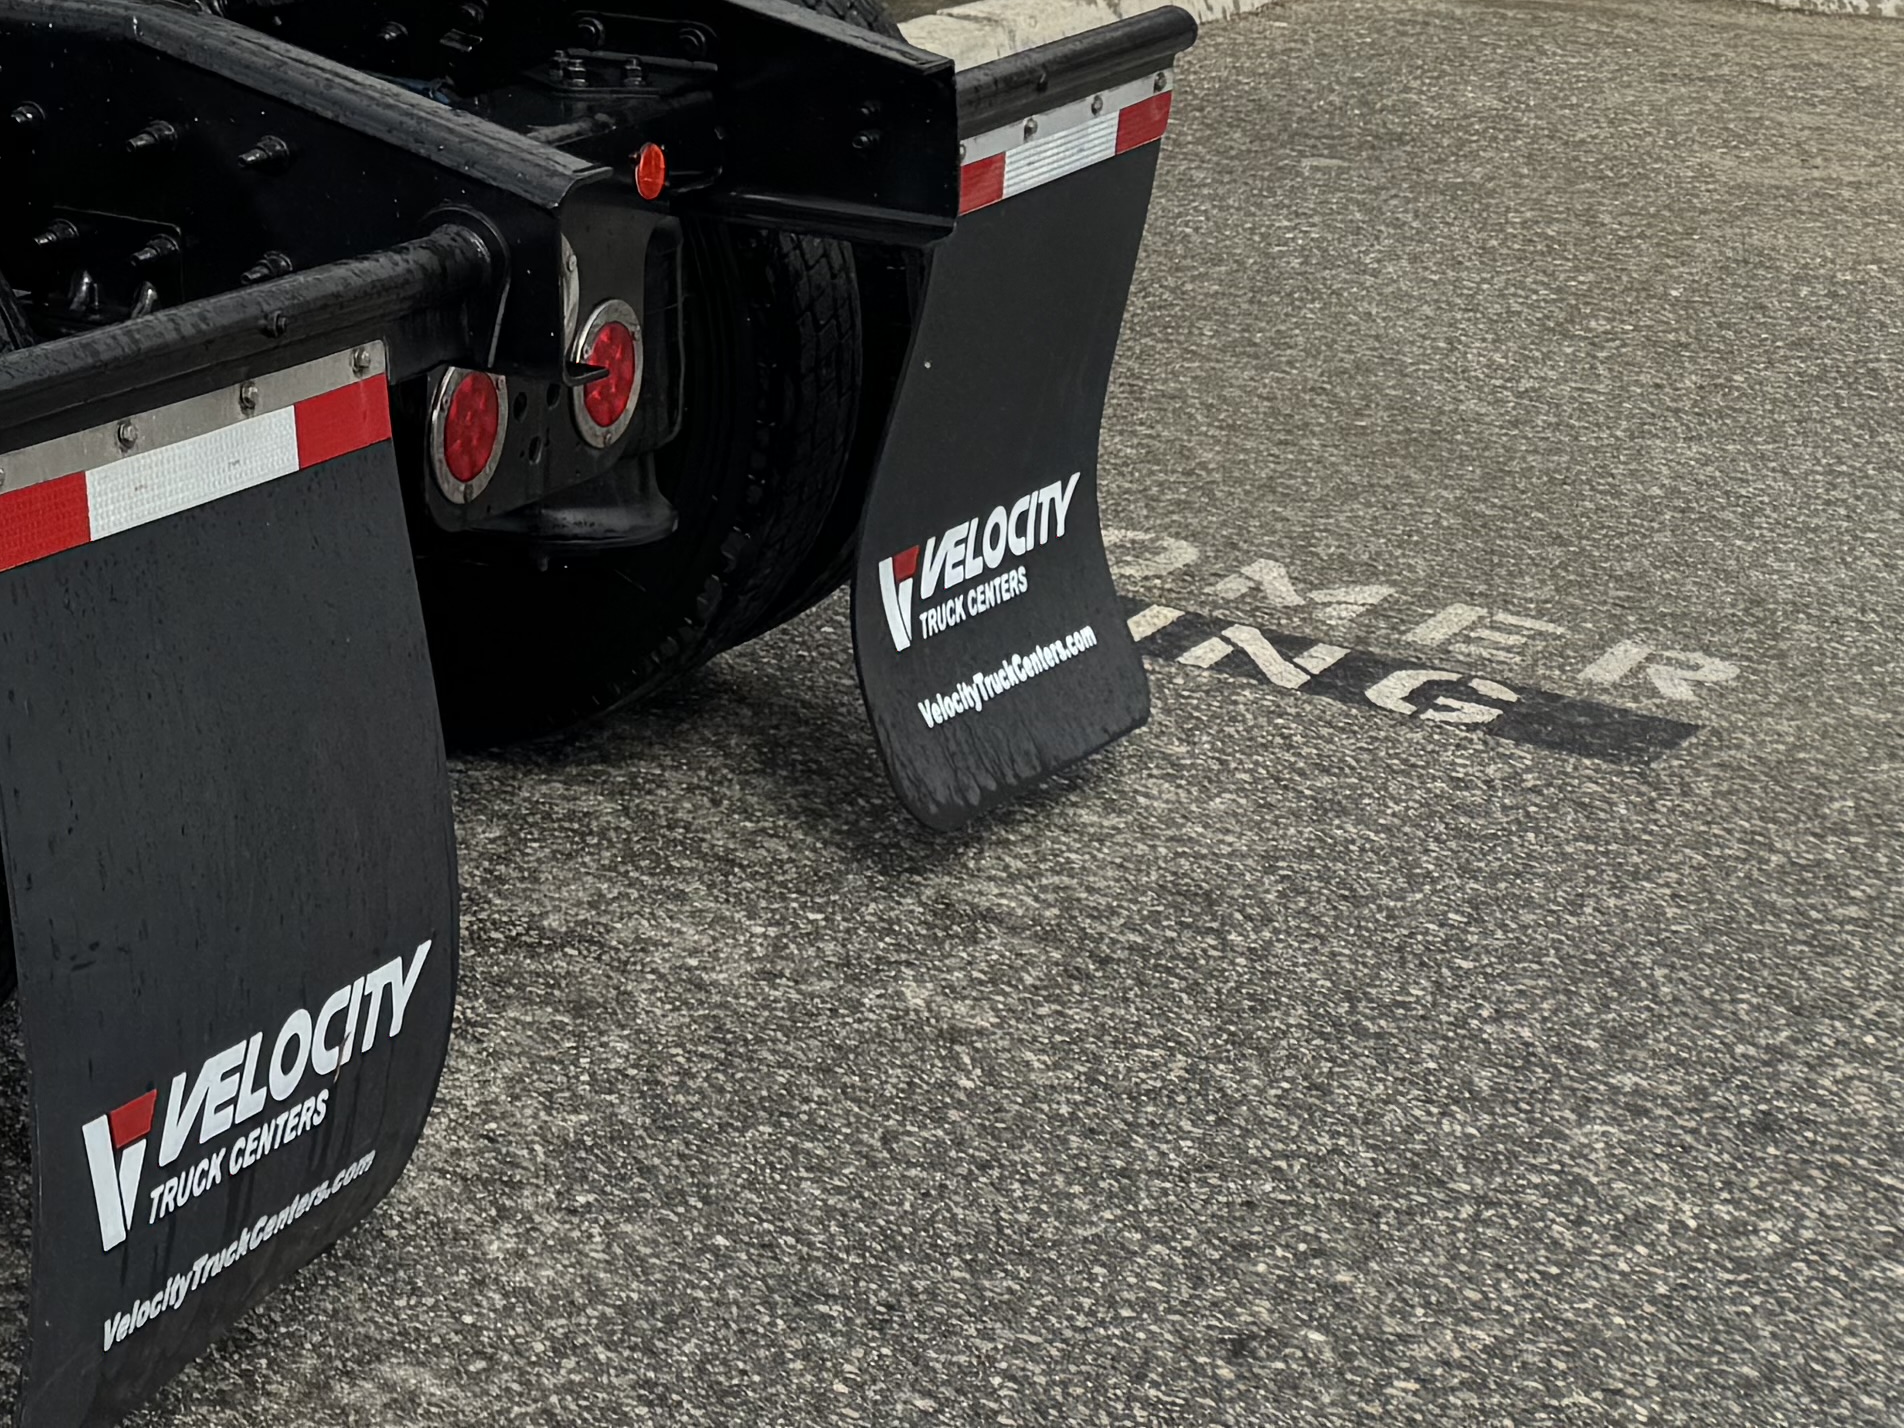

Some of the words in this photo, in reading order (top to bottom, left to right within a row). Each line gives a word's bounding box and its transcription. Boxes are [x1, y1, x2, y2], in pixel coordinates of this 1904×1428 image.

[920, 471, 1081, 600] VELOCITY
[919, 597, 965, 640] TRUCK
[967, 565, 1028, 617] CENTERS
[917, 625, 1097, 728] VelocityTruckCenters.com
[157, 940, 432, 1167] VELOCITY
[149, 1147, 226, 1224] TRUCK
[229, 1089, 329, 1175] CENTERS
[103, 1150, 376, 1352] VelocityTruckCenters.com
